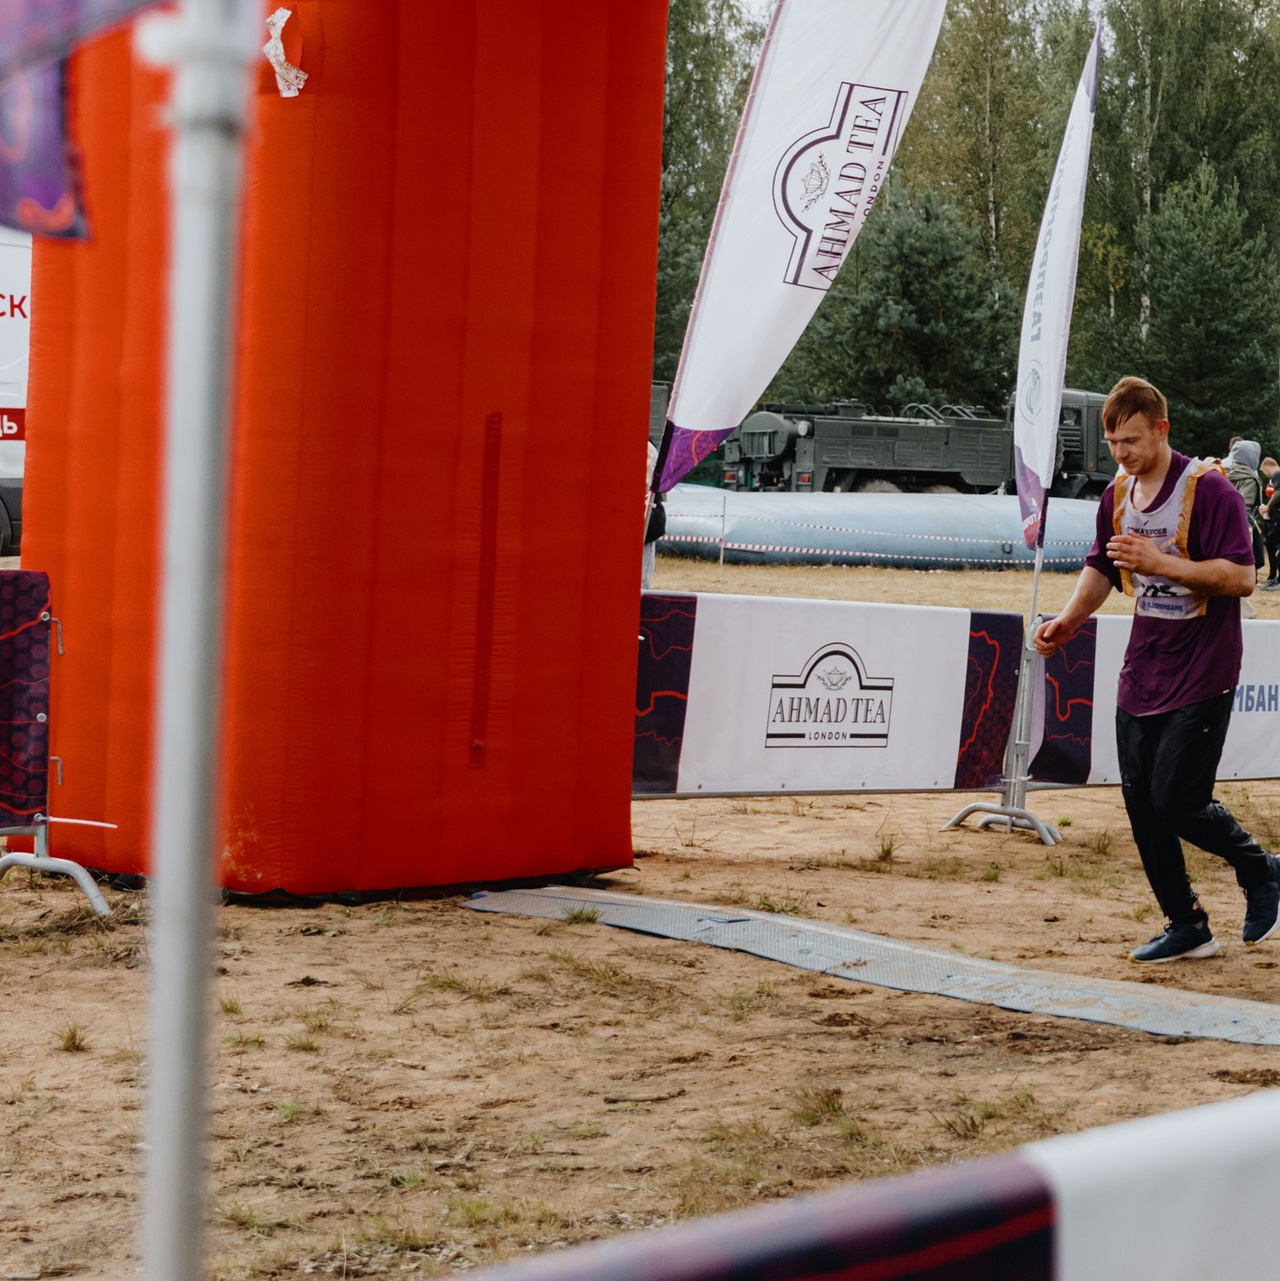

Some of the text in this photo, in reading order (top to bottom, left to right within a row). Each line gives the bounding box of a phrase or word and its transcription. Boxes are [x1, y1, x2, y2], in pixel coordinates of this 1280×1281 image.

[812, 96, 887, 282] AHMAD TEA
[860, 160, 884, 224] ONDON
[772, 697, 886, 724] AHMAD TEA
[808, 731, 848, 740] LONDON
